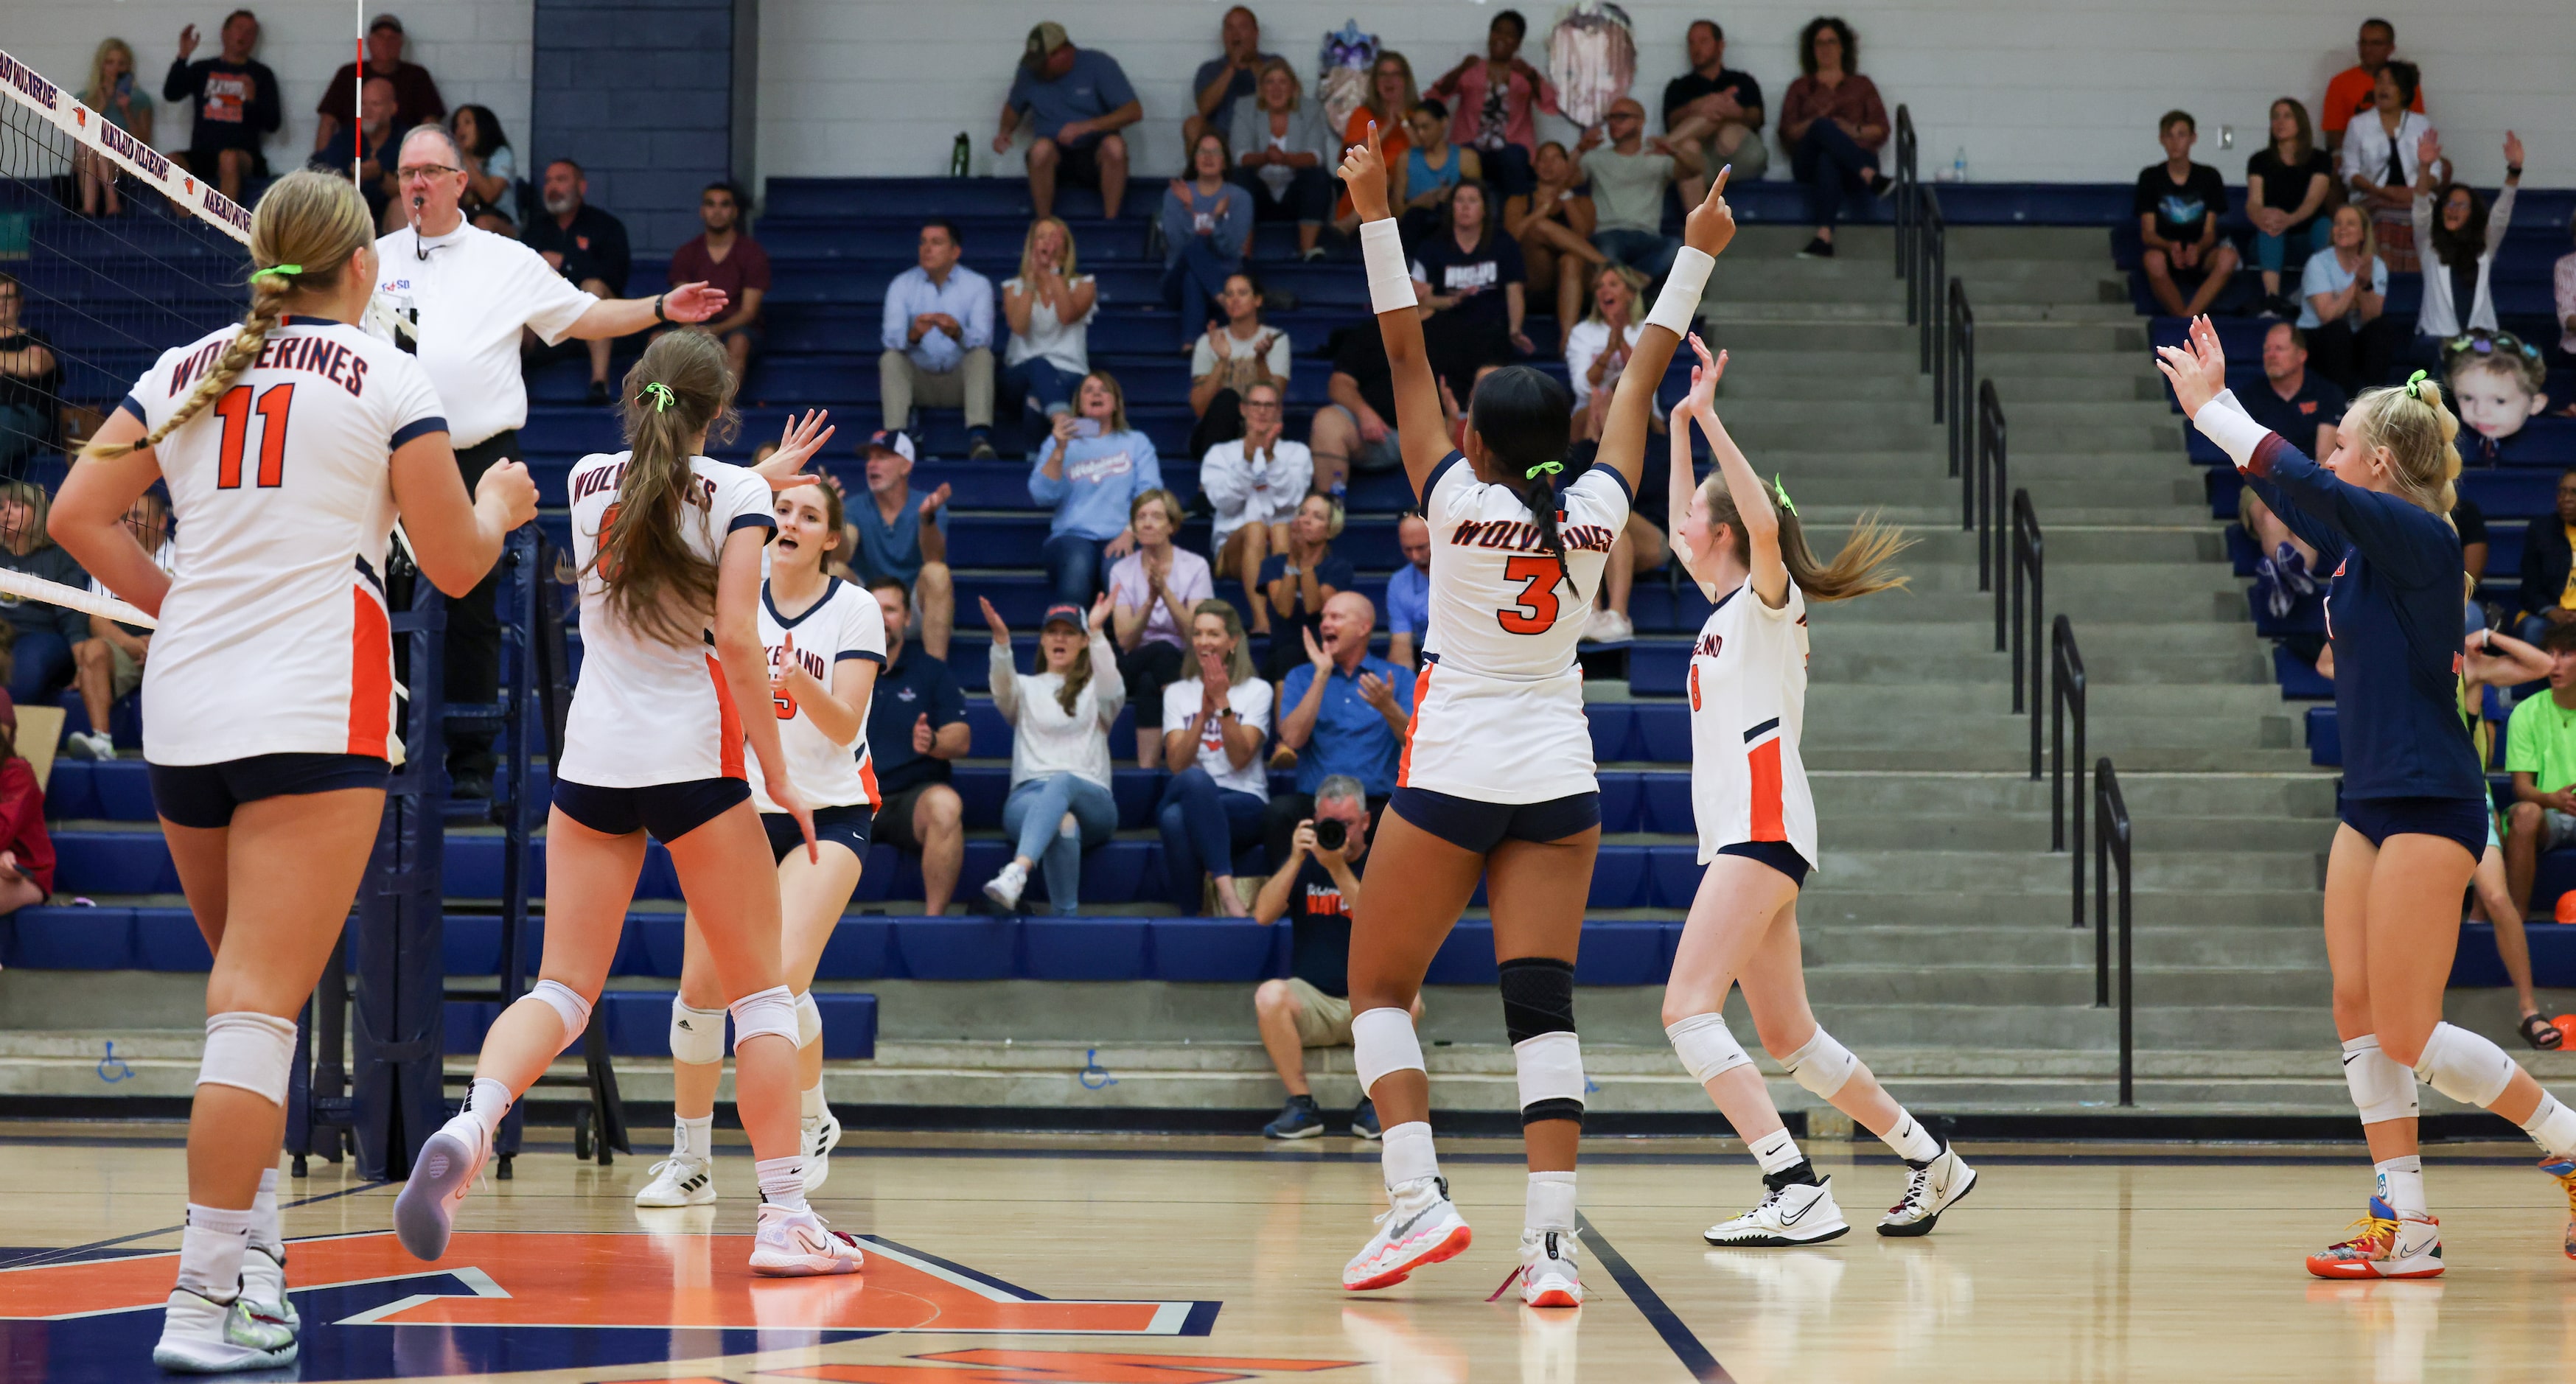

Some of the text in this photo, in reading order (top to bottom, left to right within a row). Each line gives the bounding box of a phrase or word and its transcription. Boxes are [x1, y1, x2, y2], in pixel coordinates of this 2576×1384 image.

[169, 336, 368, 399] WOERINES
[213, 382, 296, 490] 11
[1496, 555, 1561, 635] 3
[1691, 663, 1702, 713] 8
